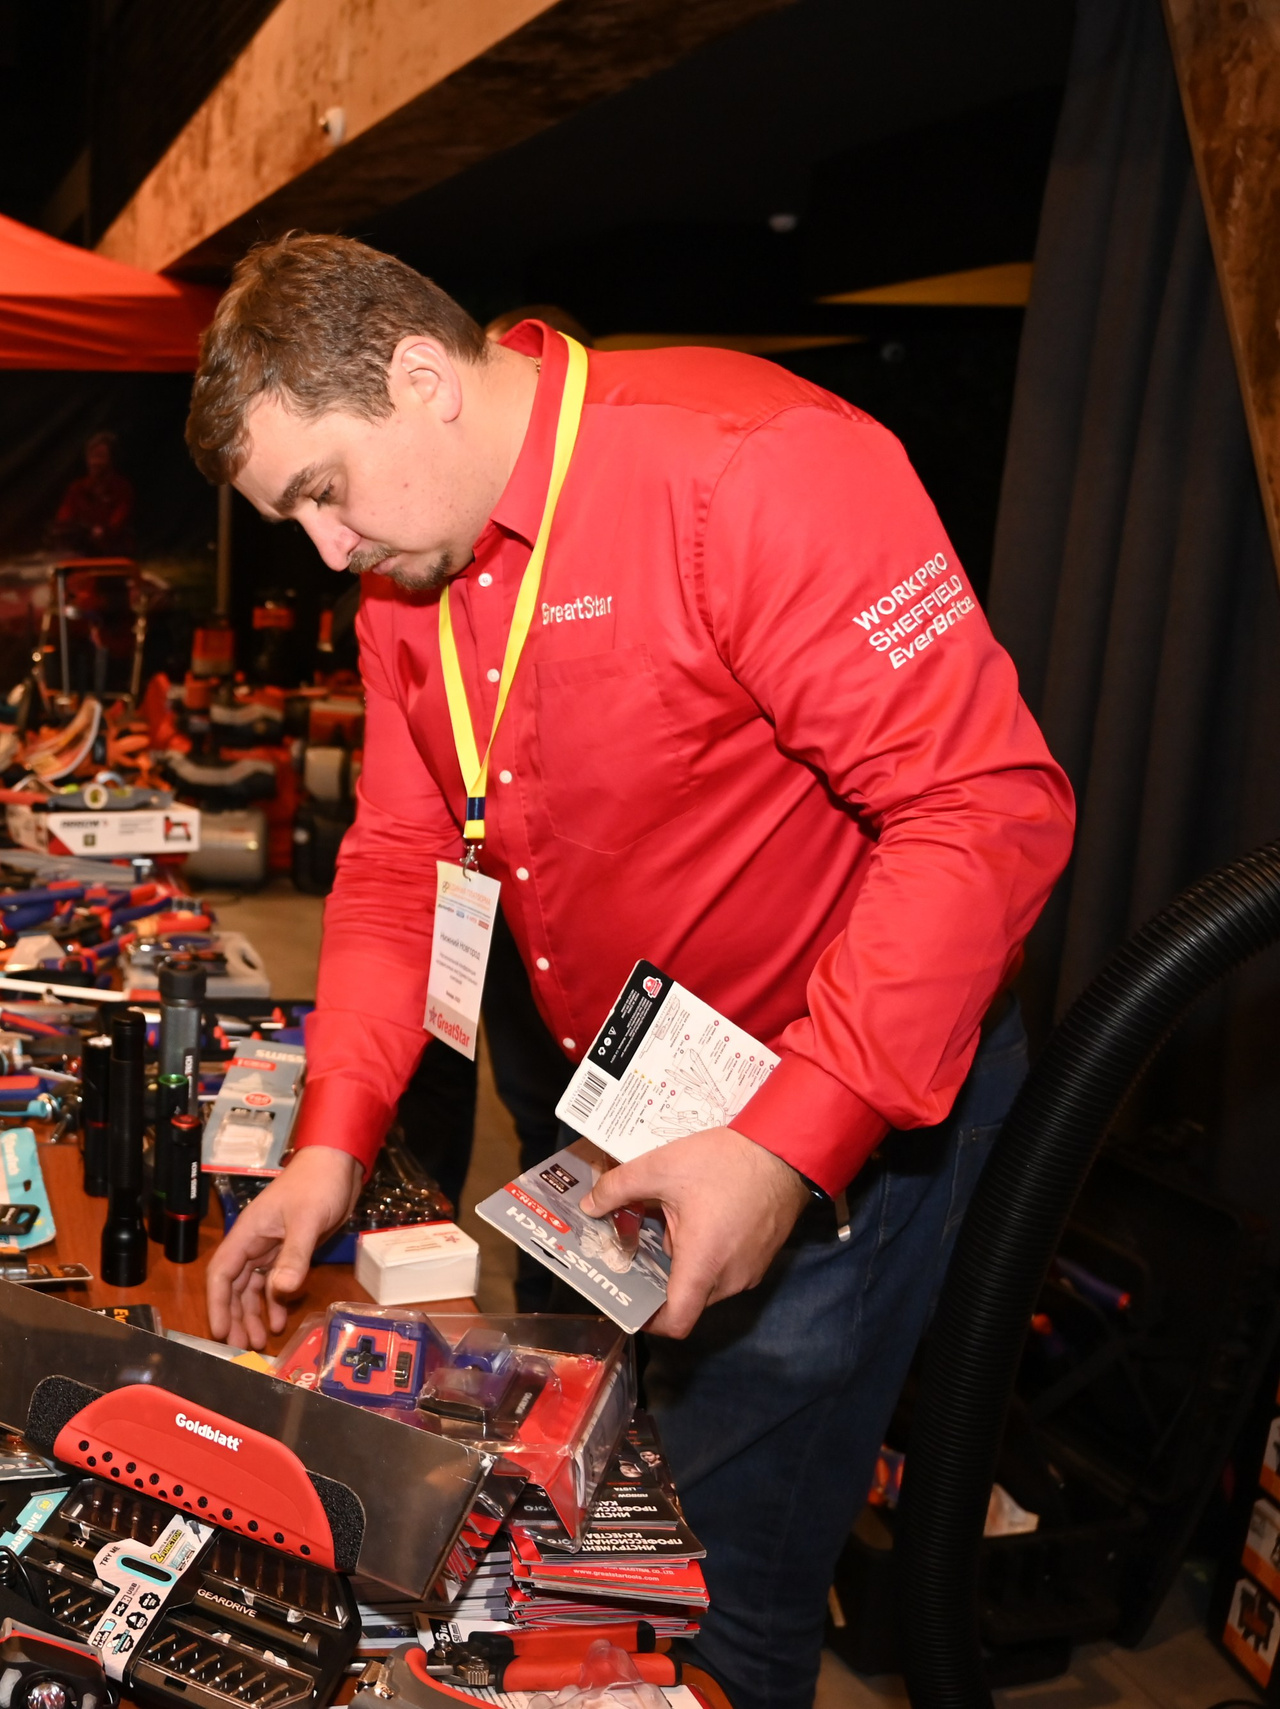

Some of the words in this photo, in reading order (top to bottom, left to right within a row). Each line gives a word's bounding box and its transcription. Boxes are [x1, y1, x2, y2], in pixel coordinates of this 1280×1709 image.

[852, 552, 948, 631] WORKPRO
[542, 595, 612, 625] GreatStar
[868, 574, 963, 652] SHEFFIELD
[888, 595, 975, 670] EverBrite
[437, 1011, 471, 1048] GreatStar
[174, 1412, 240, 1452] Goldblatt
[99, 1552, 112, 1566] TRY
[111, 1546, 121, 1554] ME
[150, 1552, 164, 1563] 2
[161, 1529, 182, 1558] FUNCTION
[126, 1582, 138, 1595] USB
[573, 1569, 660, 1582] www.greatstartools.com
[197, 1587, 258, 1618] GEARDRIVE
